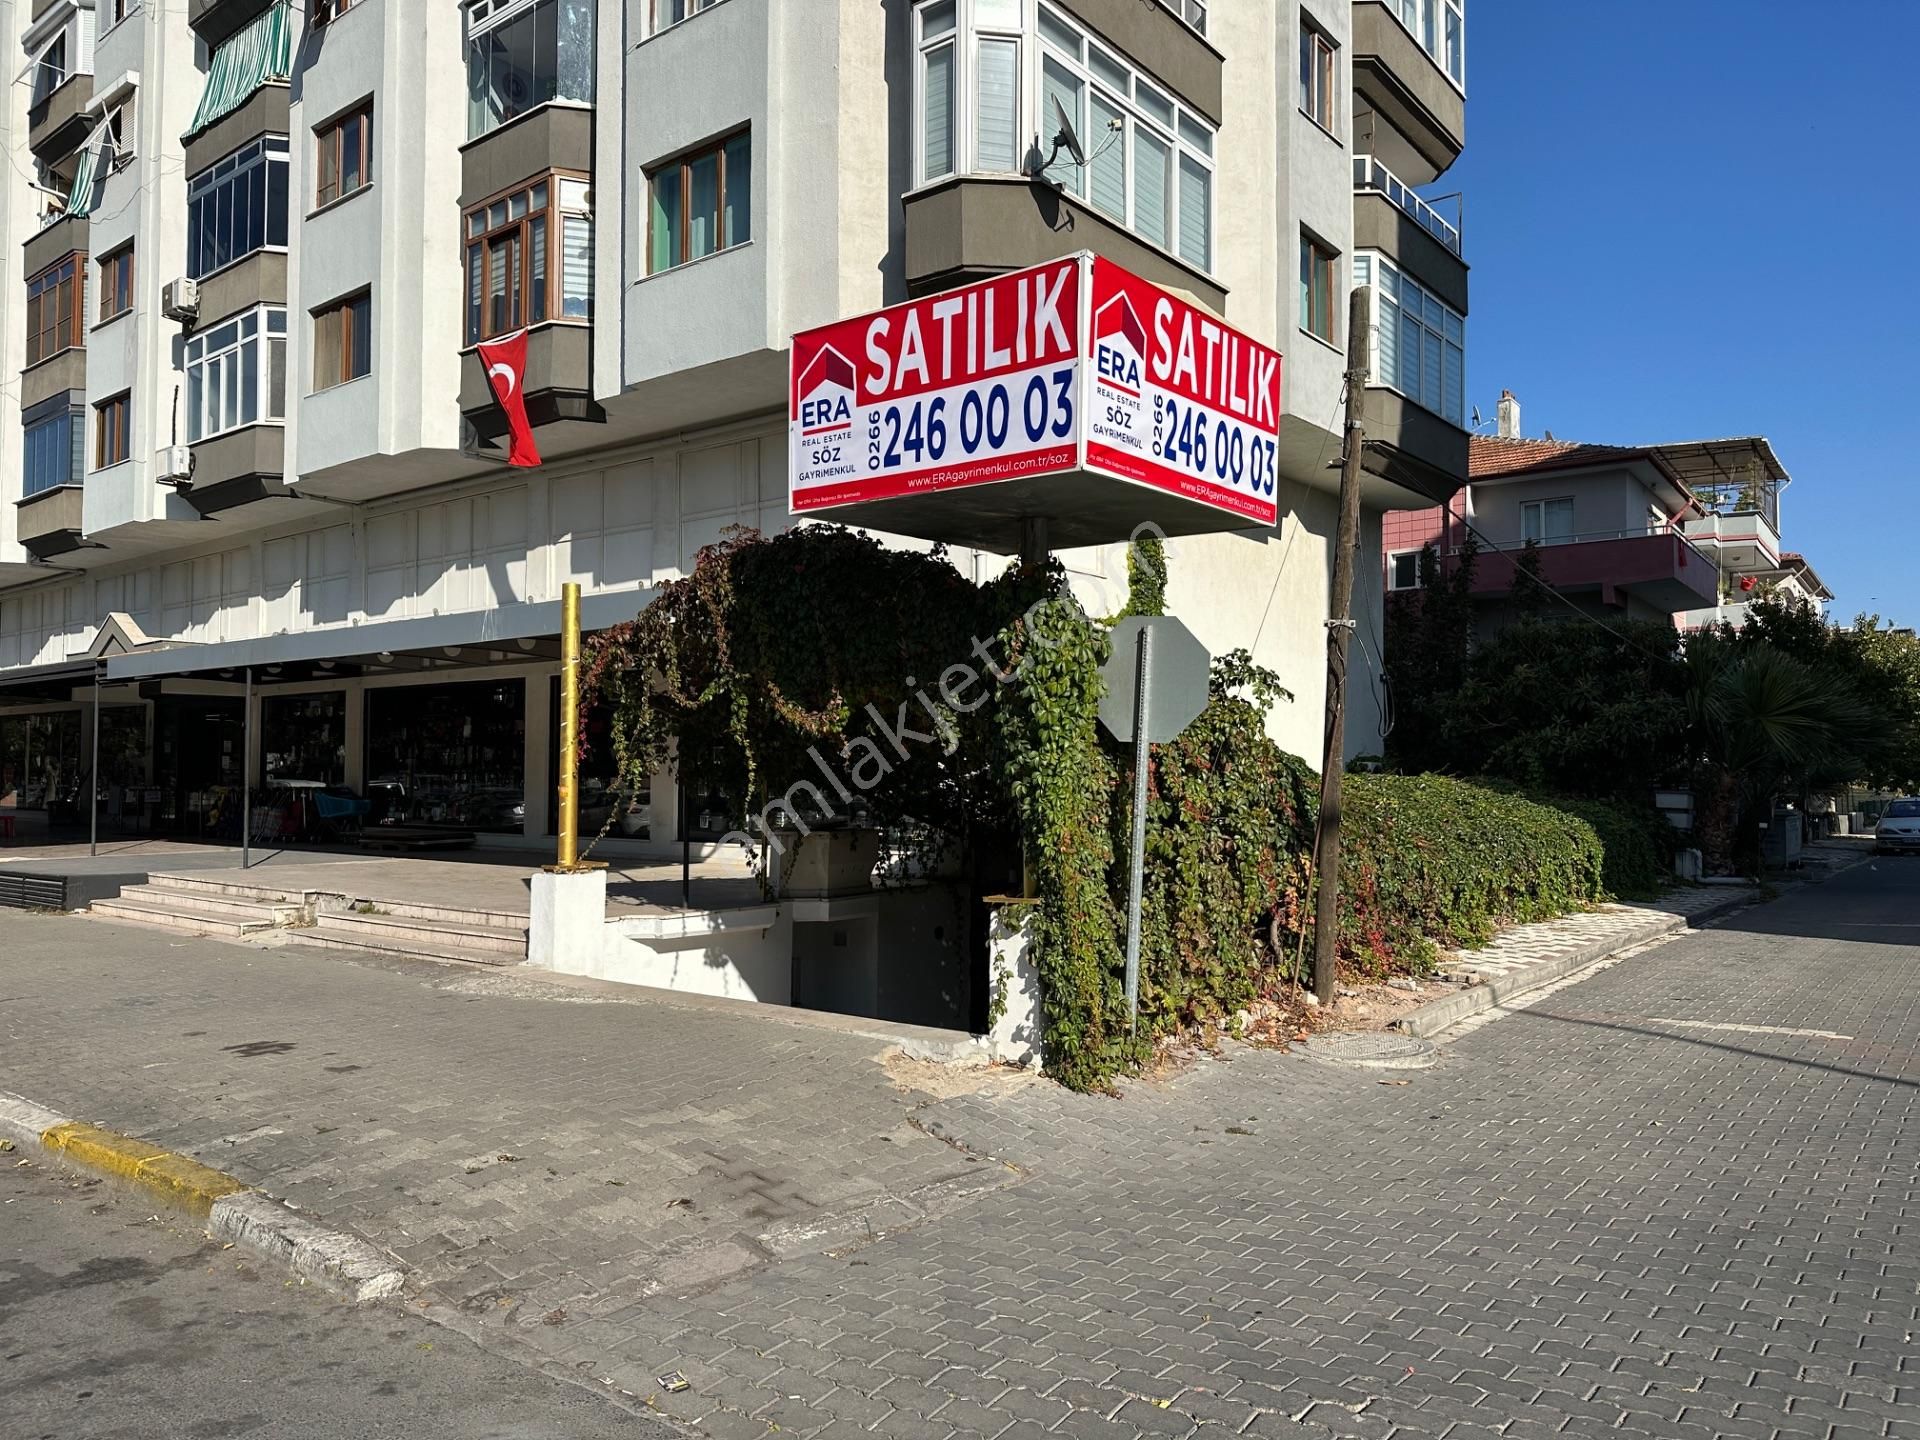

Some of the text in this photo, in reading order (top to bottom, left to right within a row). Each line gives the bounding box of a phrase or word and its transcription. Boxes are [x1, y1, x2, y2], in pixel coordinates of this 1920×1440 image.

[864, 266, 1072, 396] SATILIK
[1097, 343, 1140, 389] ERA
[1152, 297, 1277, 428] SATILIK
[802, 395, 851, 428] ERA
[883, 369, 1073, 468] 246 00 03
[1097, 386, 1141, 411] REAL ESTATE
[1106, 405, 1132, 429] SÖZ
[801, 431, 852, 447] REAL ESTATE
[868, 410, 880, 471] 0266
[1152, 393, 1163, 456] 0266
[1164, 398, 1275, 496] 246 00 03
[812, 445, 841, 465] SÖZ
[907, 452, 1069, 488] www.ERAgayrimenkul.com.tr/soz
